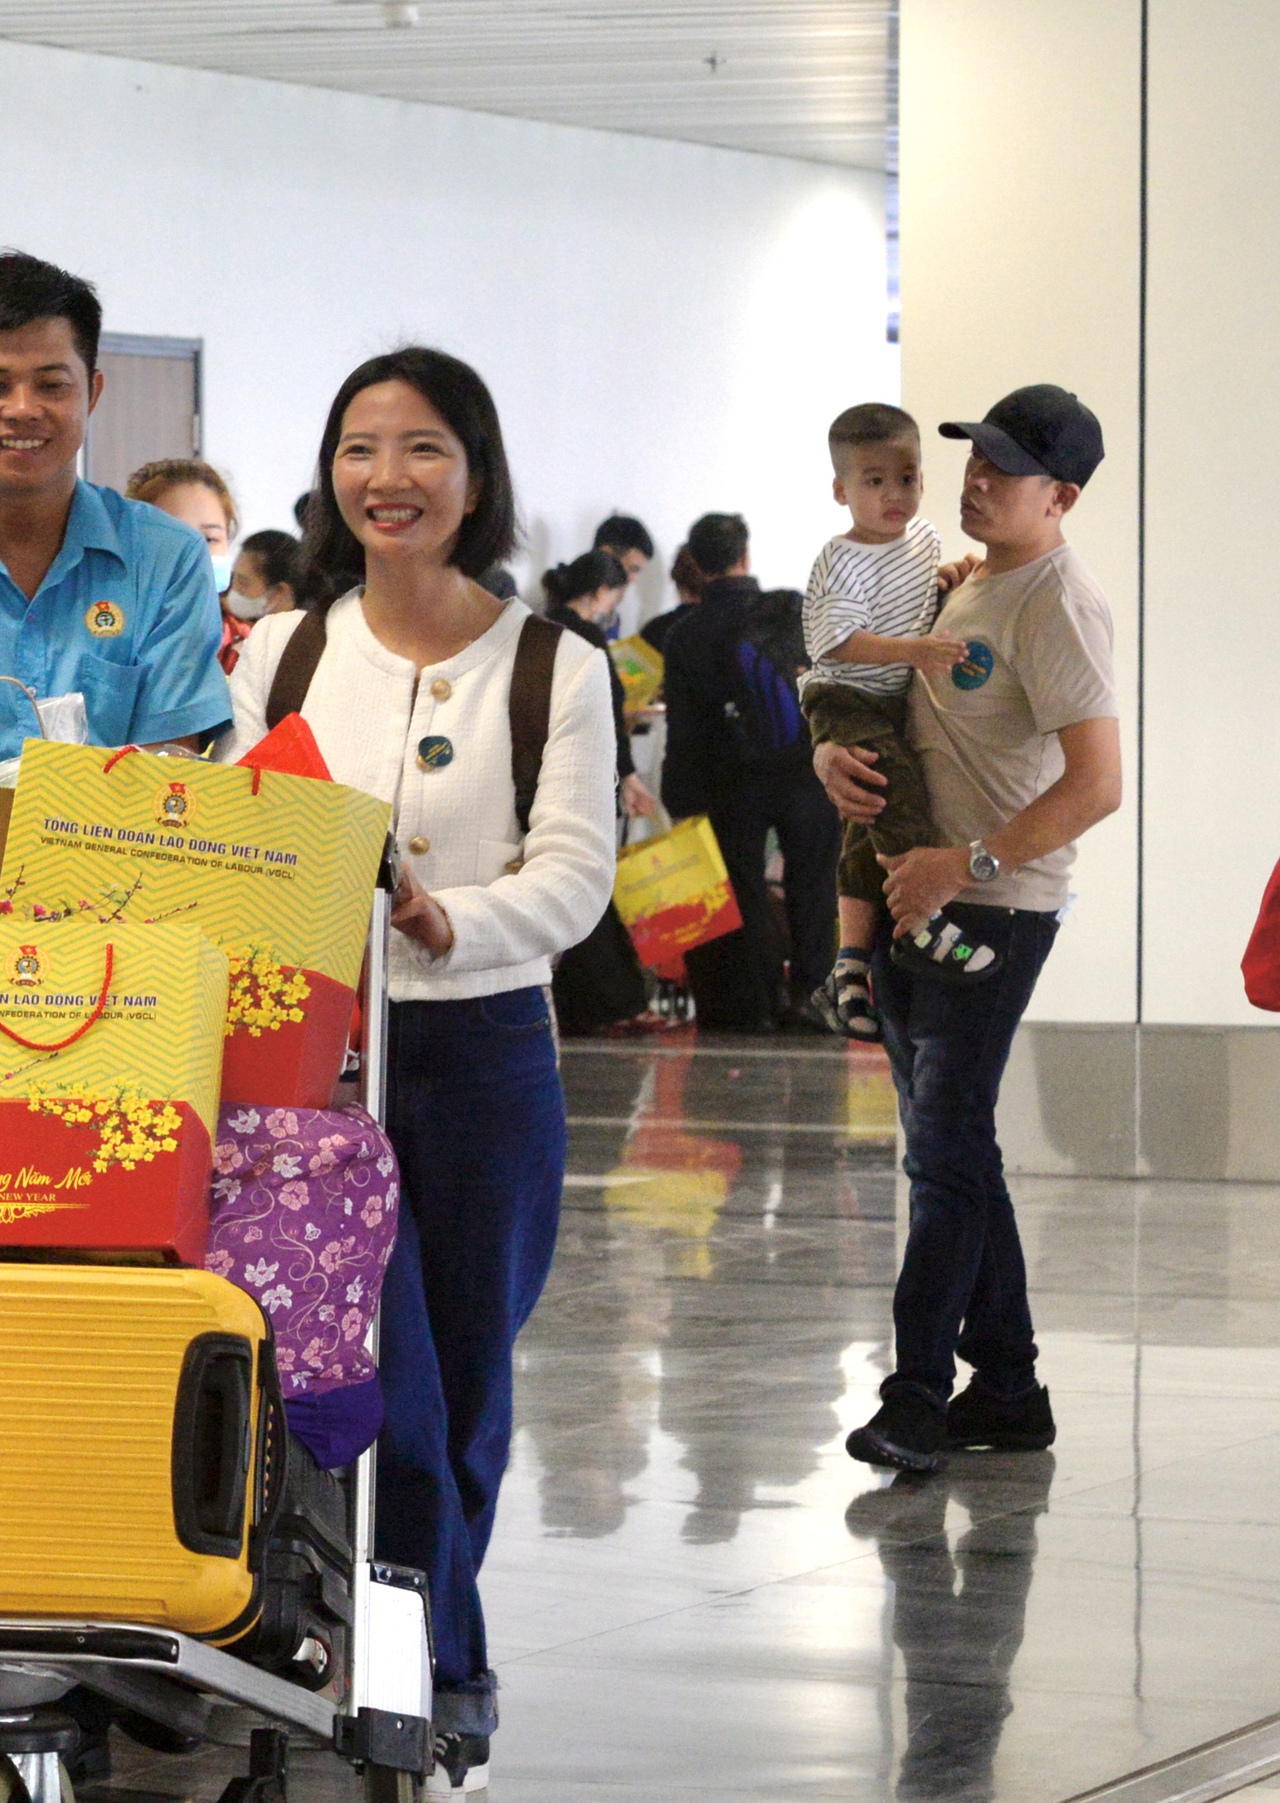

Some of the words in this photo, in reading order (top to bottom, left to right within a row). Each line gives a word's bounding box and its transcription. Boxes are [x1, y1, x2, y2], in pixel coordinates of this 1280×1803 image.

[40, 836, 82, 848] VIETNAM
[85, 842, 127, 855] GENERAL
[130, 848, 208, 867] CONFEDERATION
[210, 860, 223, 868] OF
[225, 863, 263, 874] LABOUR
[266, 868, 296, 880] (VGCL)
[159, 835, 184, 849] LAO
[264, 850, 298, 866] NAM
[14, 994, 40, 1005] LAO
[123, 996, 157, 1006] NAM
[69, 1011, 82, 1019] OF
[126, 1012, 157, 1021] (VGCL)
[14, 1165, 53, 1189] Năm
[26, 1193, 56, 1202] YEAR
